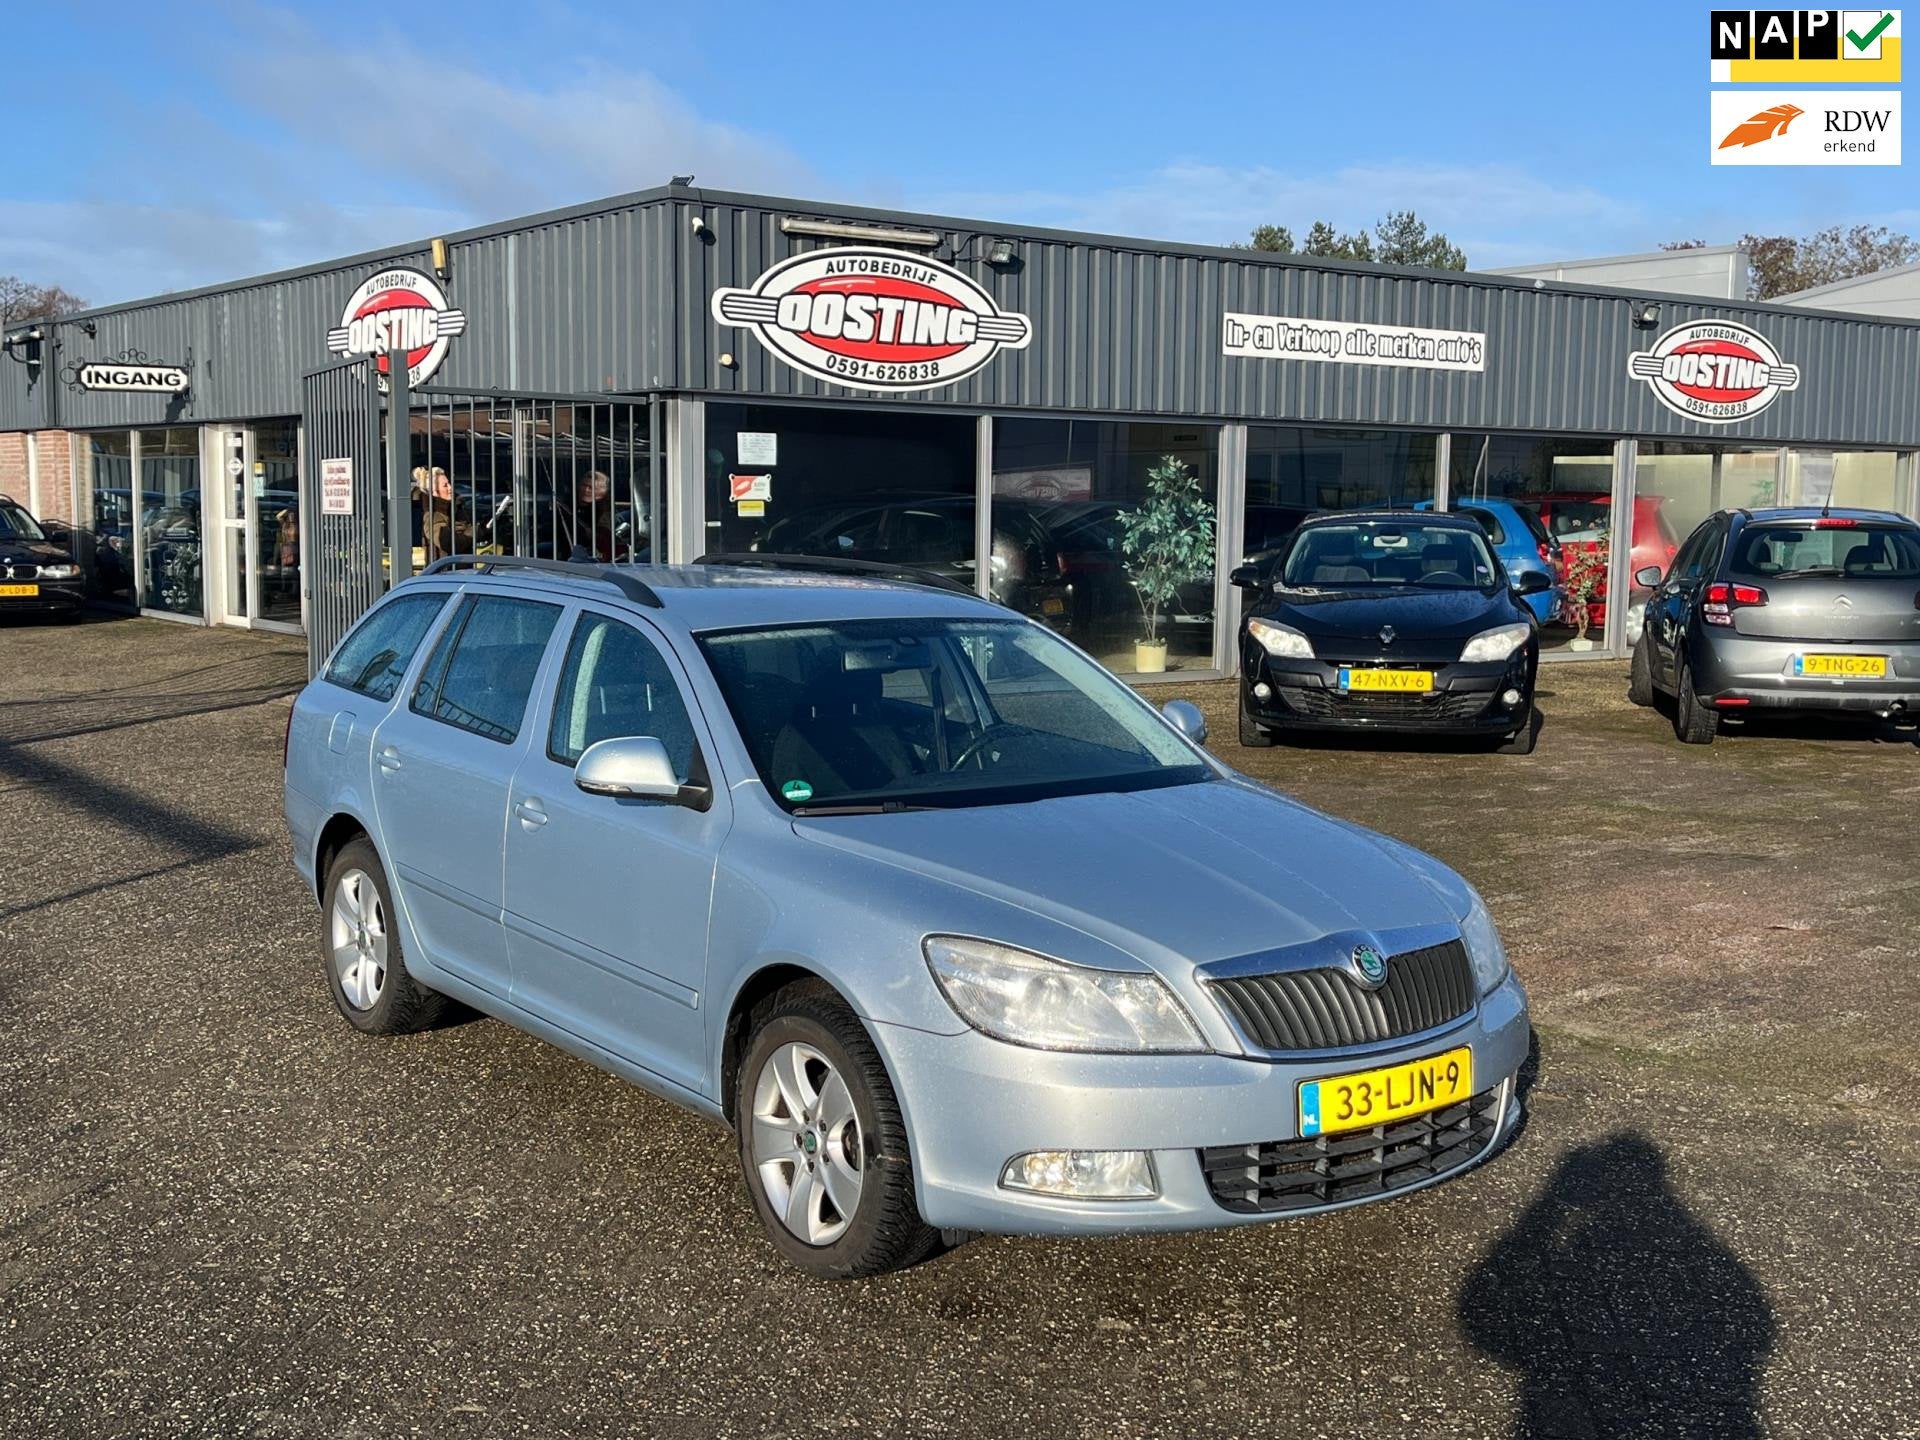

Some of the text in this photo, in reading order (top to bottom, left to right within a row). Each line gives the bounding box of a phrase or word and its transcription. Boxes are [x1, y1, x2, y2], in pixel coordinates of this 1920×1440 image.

[366, 273, 417, 296] AUTOBEDRIJF
[825, 260, 938, 285] AUTOBEDRIJF
[776, 290, 979, 346] OOSTING
[348, 307, 438, 355] OOSTING
[1226, 319, 1482, 364] In- en Verkoop alle merken auto's
[1689, 328, 1750, 345] AUTOBEDRIJF
[86, 370, 181, 387] INGANG
[825, 354, 940, 381] 0591-626838
[1662, 352, 1770, 390] OOSTING
[1685, 398, 1748, 416] 0591-626838
[1808, 658, 1880, 672] 9-TNG-26
[1353, 674, 1425, 688] 47-NXV-6
[1336, 1060, 1459, 1121] 33-LJN-9
[1304, 1113, 1318, 1125] NL
